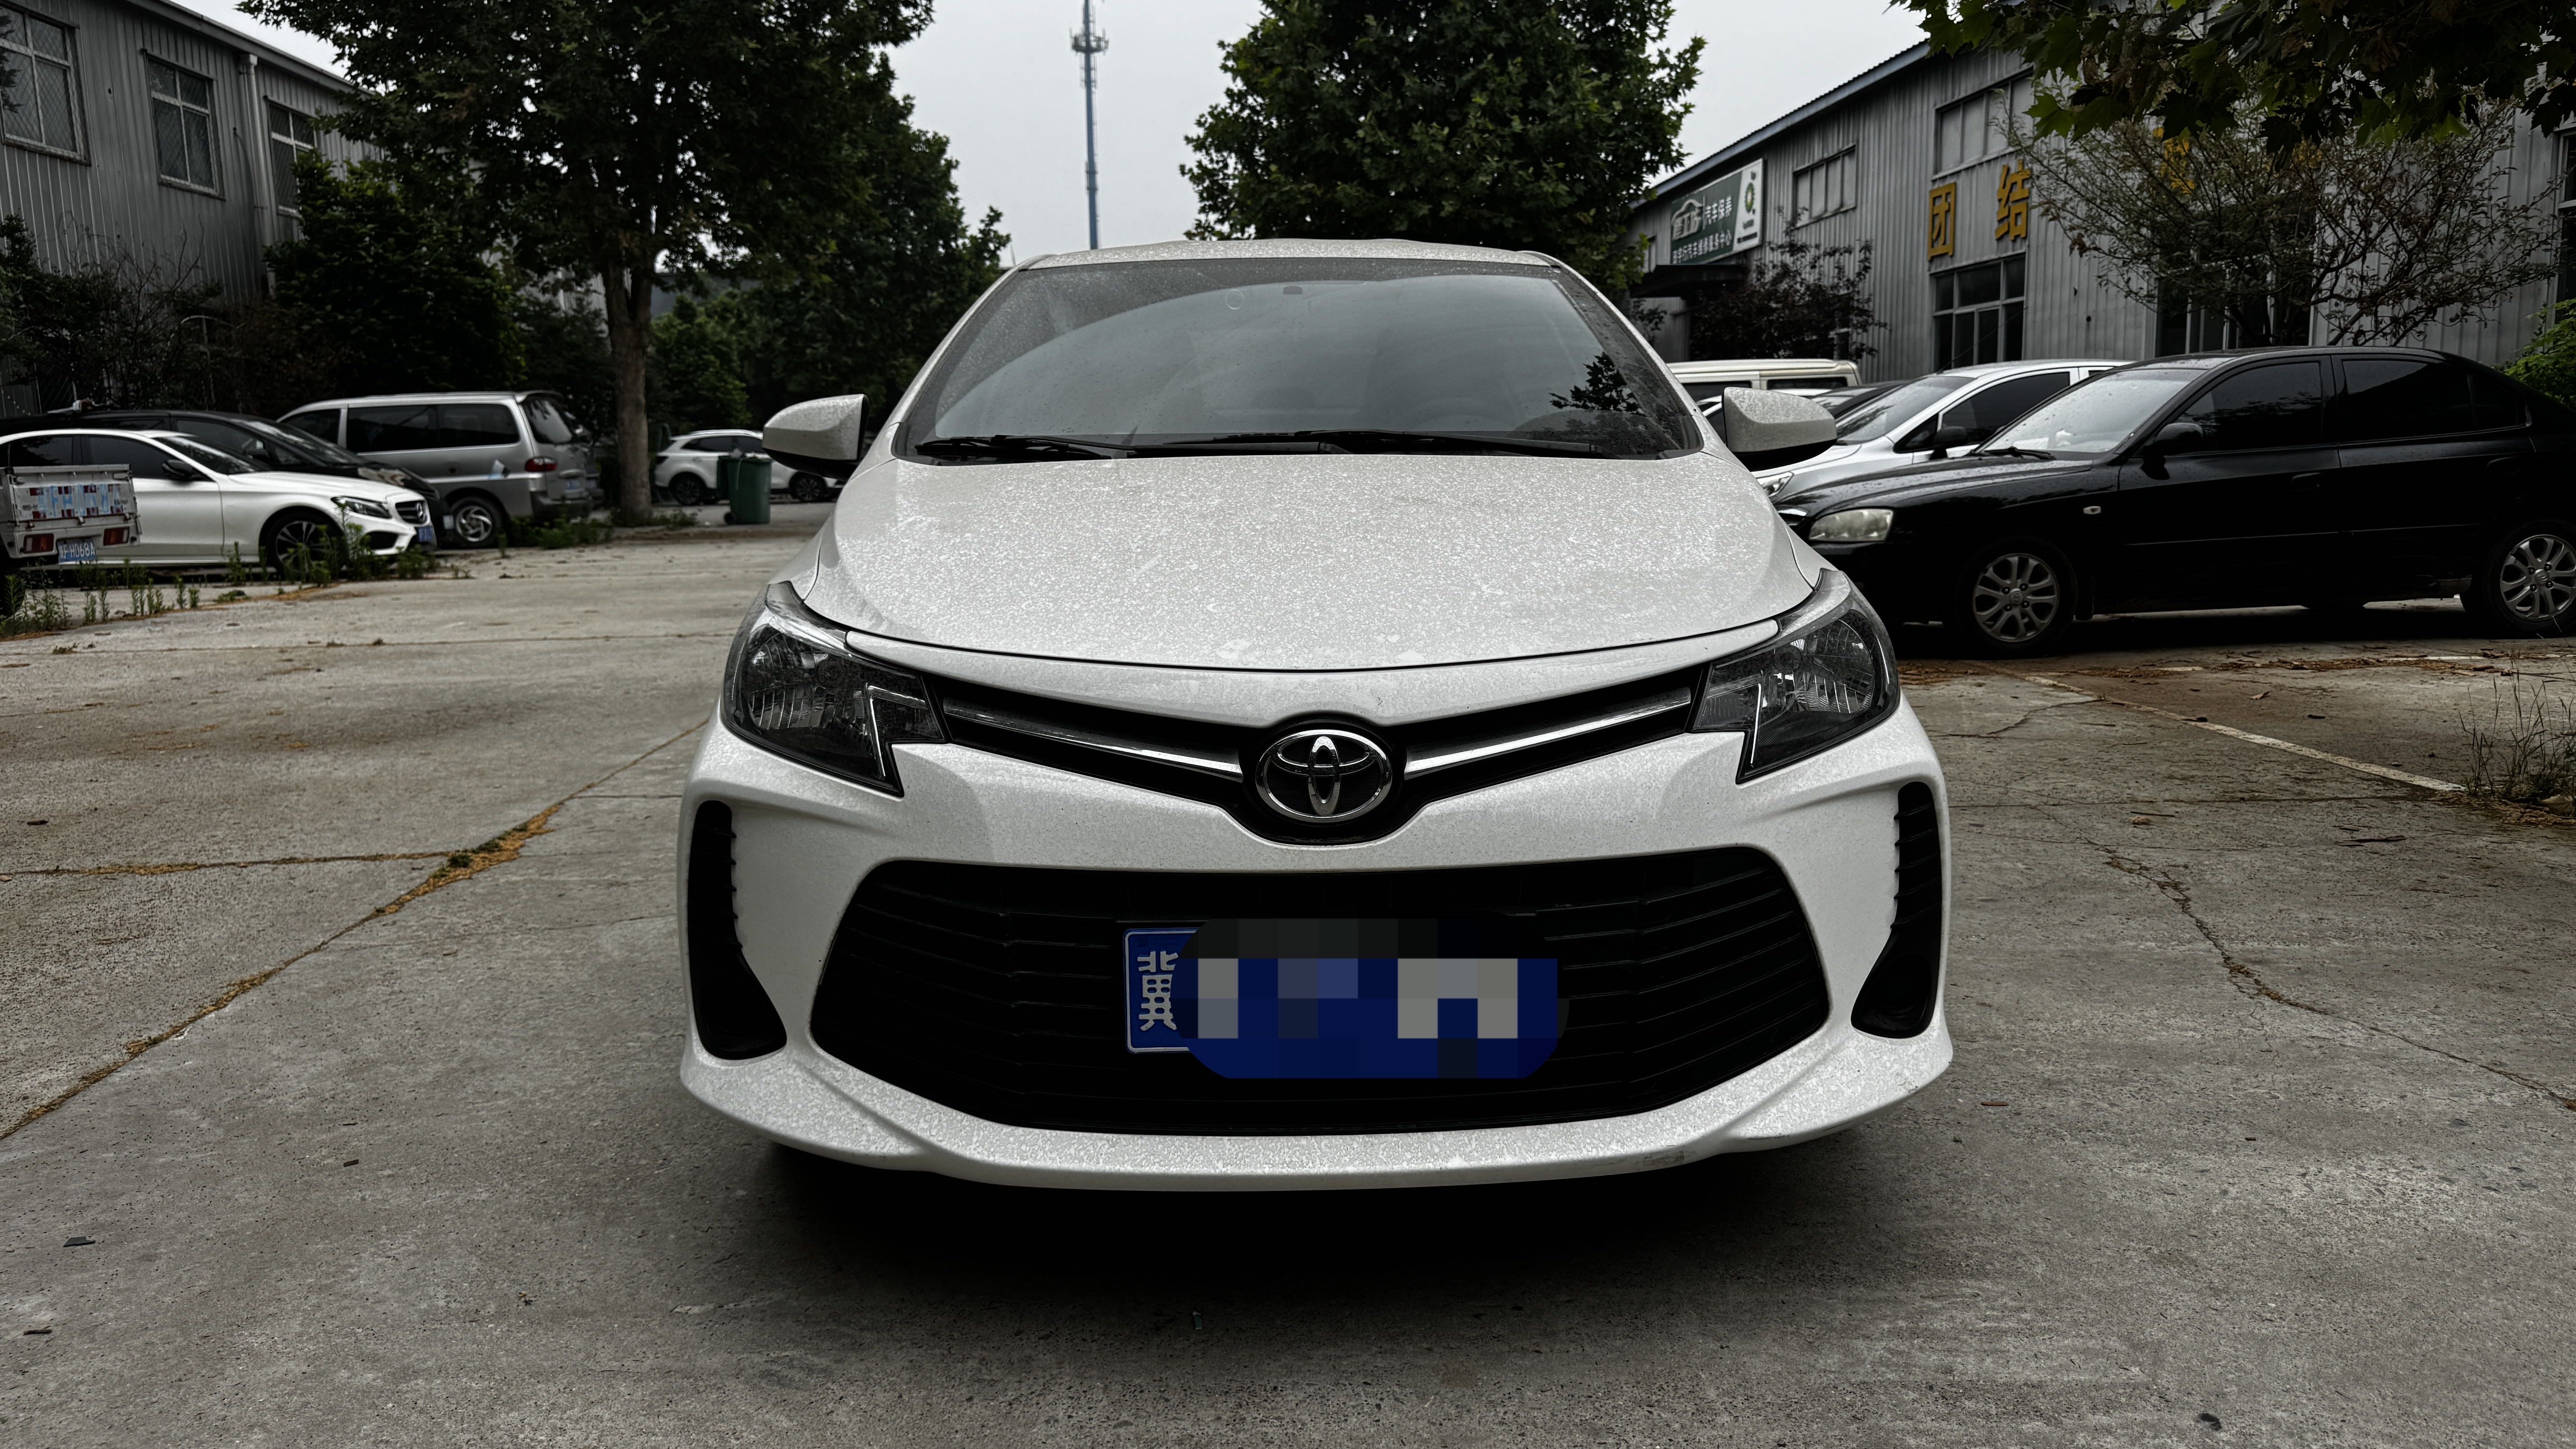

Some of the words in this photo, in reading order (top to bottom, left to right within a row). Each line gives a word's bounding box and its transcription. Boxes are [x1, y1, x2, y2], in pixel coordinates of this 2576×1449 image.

[1704, 194, 1732, 225] 汽车保养
[1137, 951, 1179, 1031] 冀
